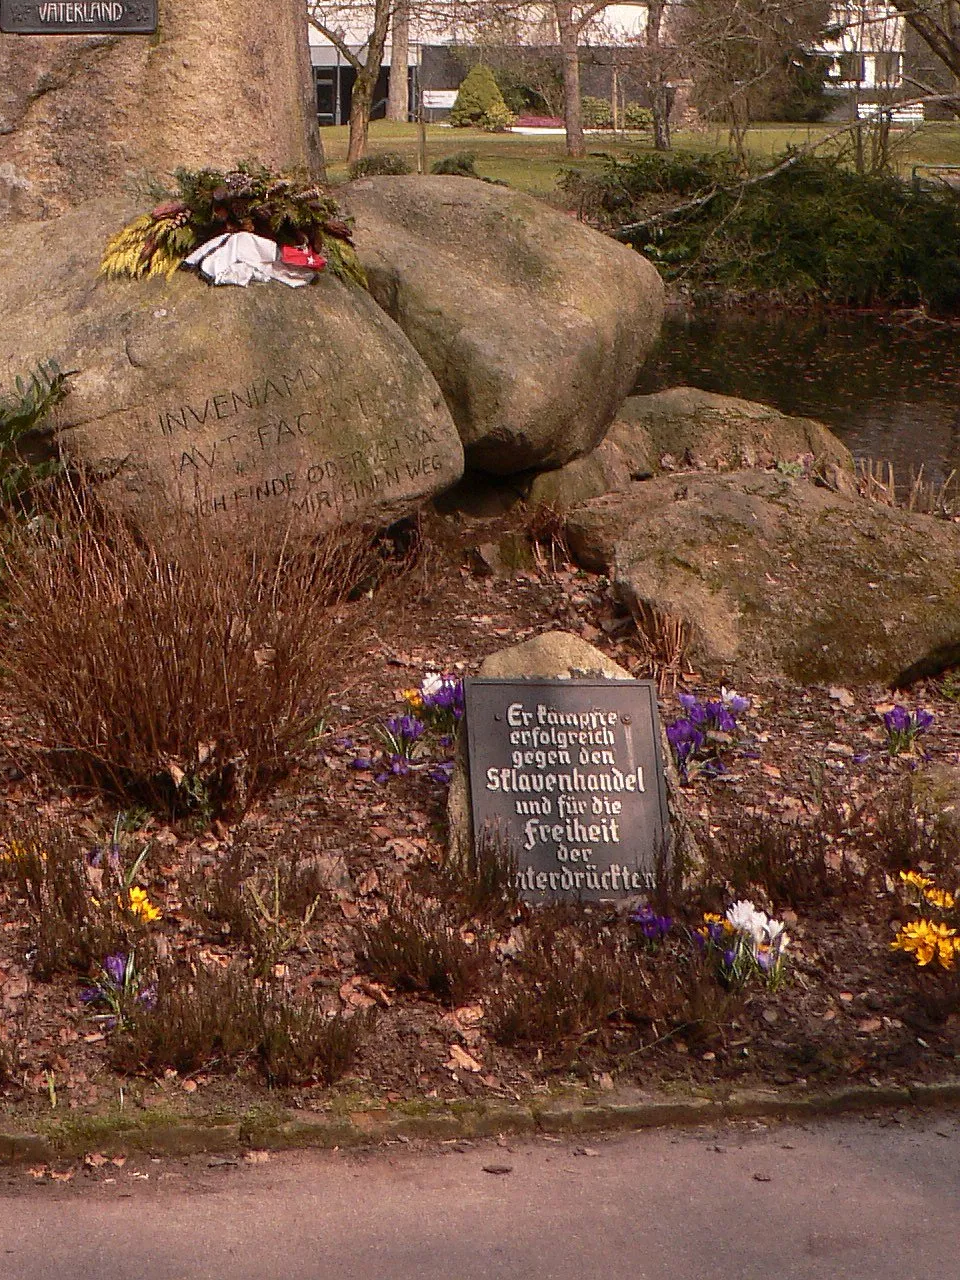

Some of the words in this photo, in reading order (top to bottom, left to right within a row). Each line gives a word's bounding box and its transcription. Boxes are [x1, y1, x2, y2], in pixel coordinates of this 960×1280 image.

[39, 2, 123, 23] VATERLAND
[159, 368, 310, 435] INVENIAM
[406, 454, 442, 481] WEG
[507, 703, 533, 727] Er
[537, 704, 618, 730] kämpfte
[510, 727, 615, 748] erfolgreich
[512, 749, 571, 769] gegen
[578, 747, 615, 765] den
[486, 767, 645, 793] Sklavenhandel
[516, 796, 552, 815] und
[557, 794, 587, 819] für
[592, 796, 622, 815] die
[523, 818, 620, 851] Freiheit
[557, 844, 593, 862] der
[507, 864, 657, 891] nterdrückten
